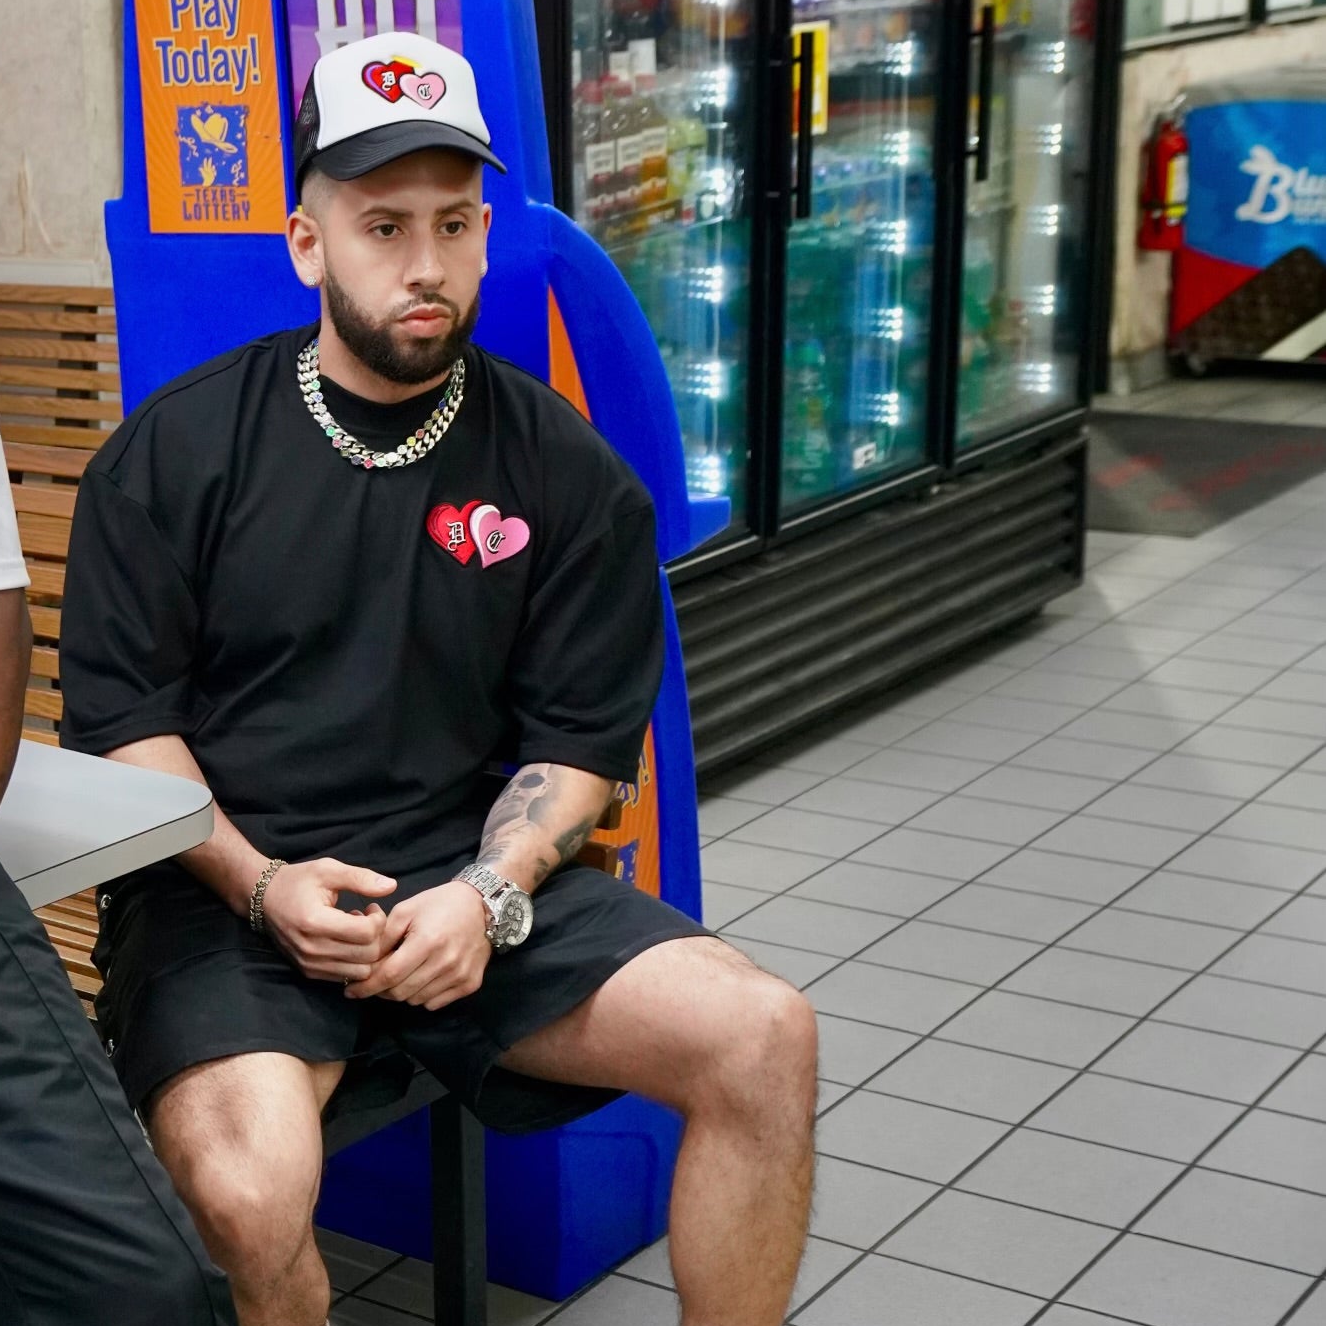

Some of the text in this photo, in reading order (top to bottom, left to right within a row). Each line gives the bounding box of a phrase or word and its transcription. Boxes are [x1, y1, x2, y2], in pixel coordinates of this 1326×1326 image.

[153, 35, 262, 95] Today!
[195, 188, 237, 203] TEXAS
[182, 200, 251, 222] LOTTERY
